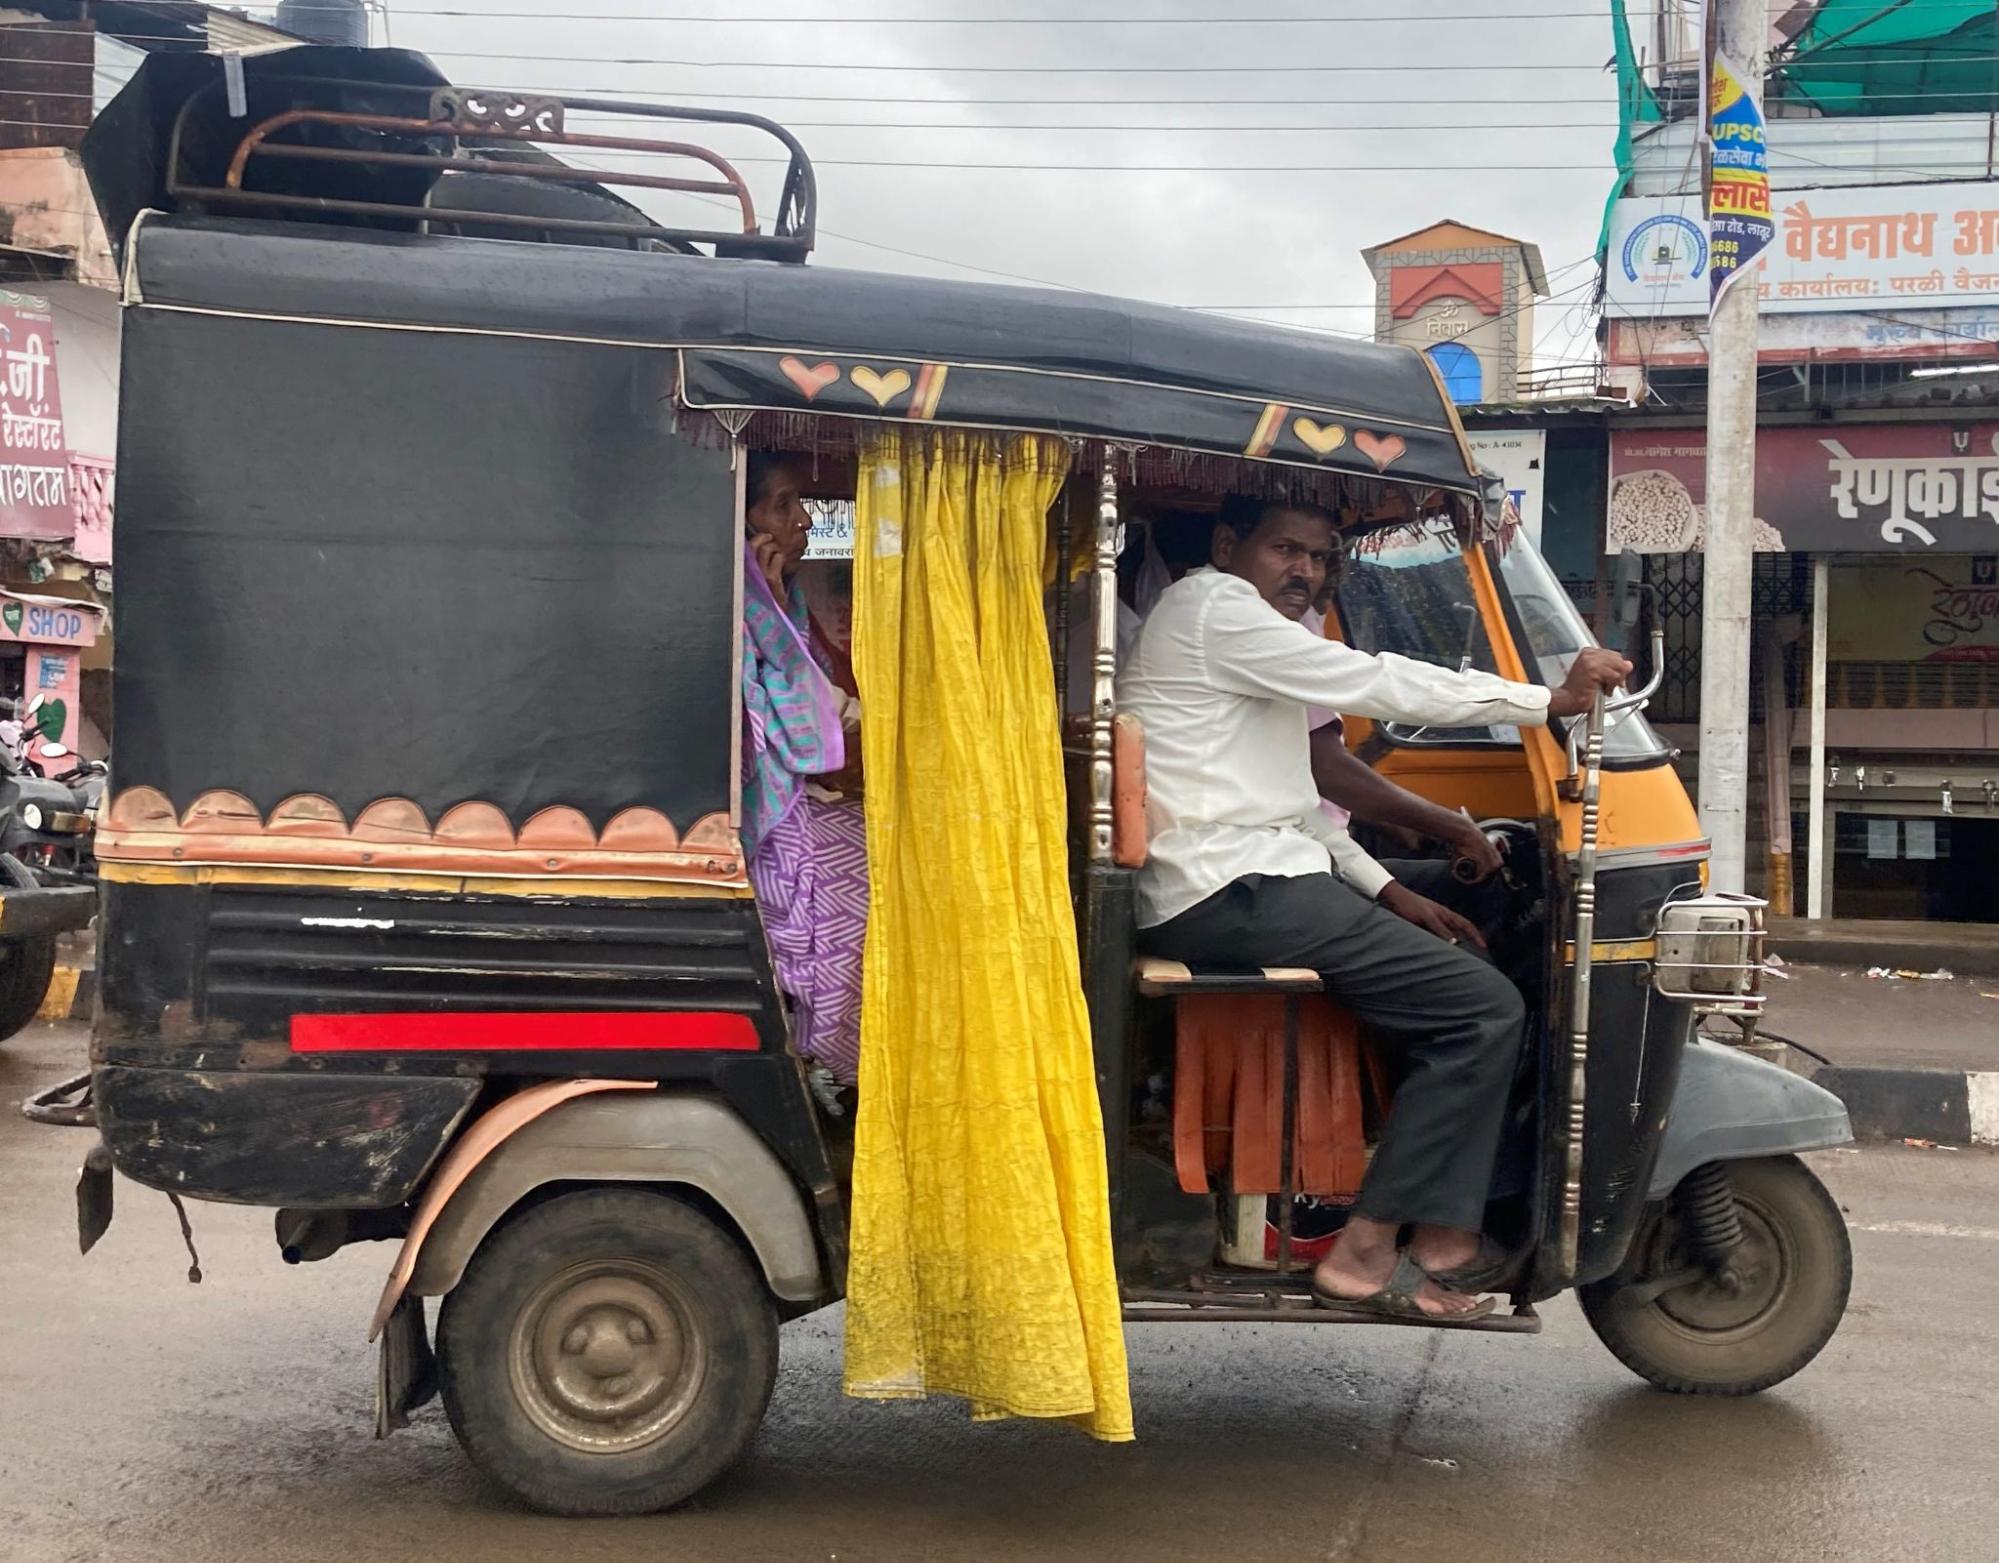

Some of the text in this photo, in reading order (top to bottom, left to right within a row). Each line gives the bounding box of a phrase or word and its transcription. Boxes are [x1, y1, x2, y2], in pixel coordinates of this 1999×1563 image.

[1712, 123, 1764, 144] UPSC
[1783, 201, 1999, 262] वैद्यनाथ अ
[1889, 269, 1945, 293] परळी
[1426, 318, 1469, 337] निवास
[29, 607, 82, 640] SHOP
